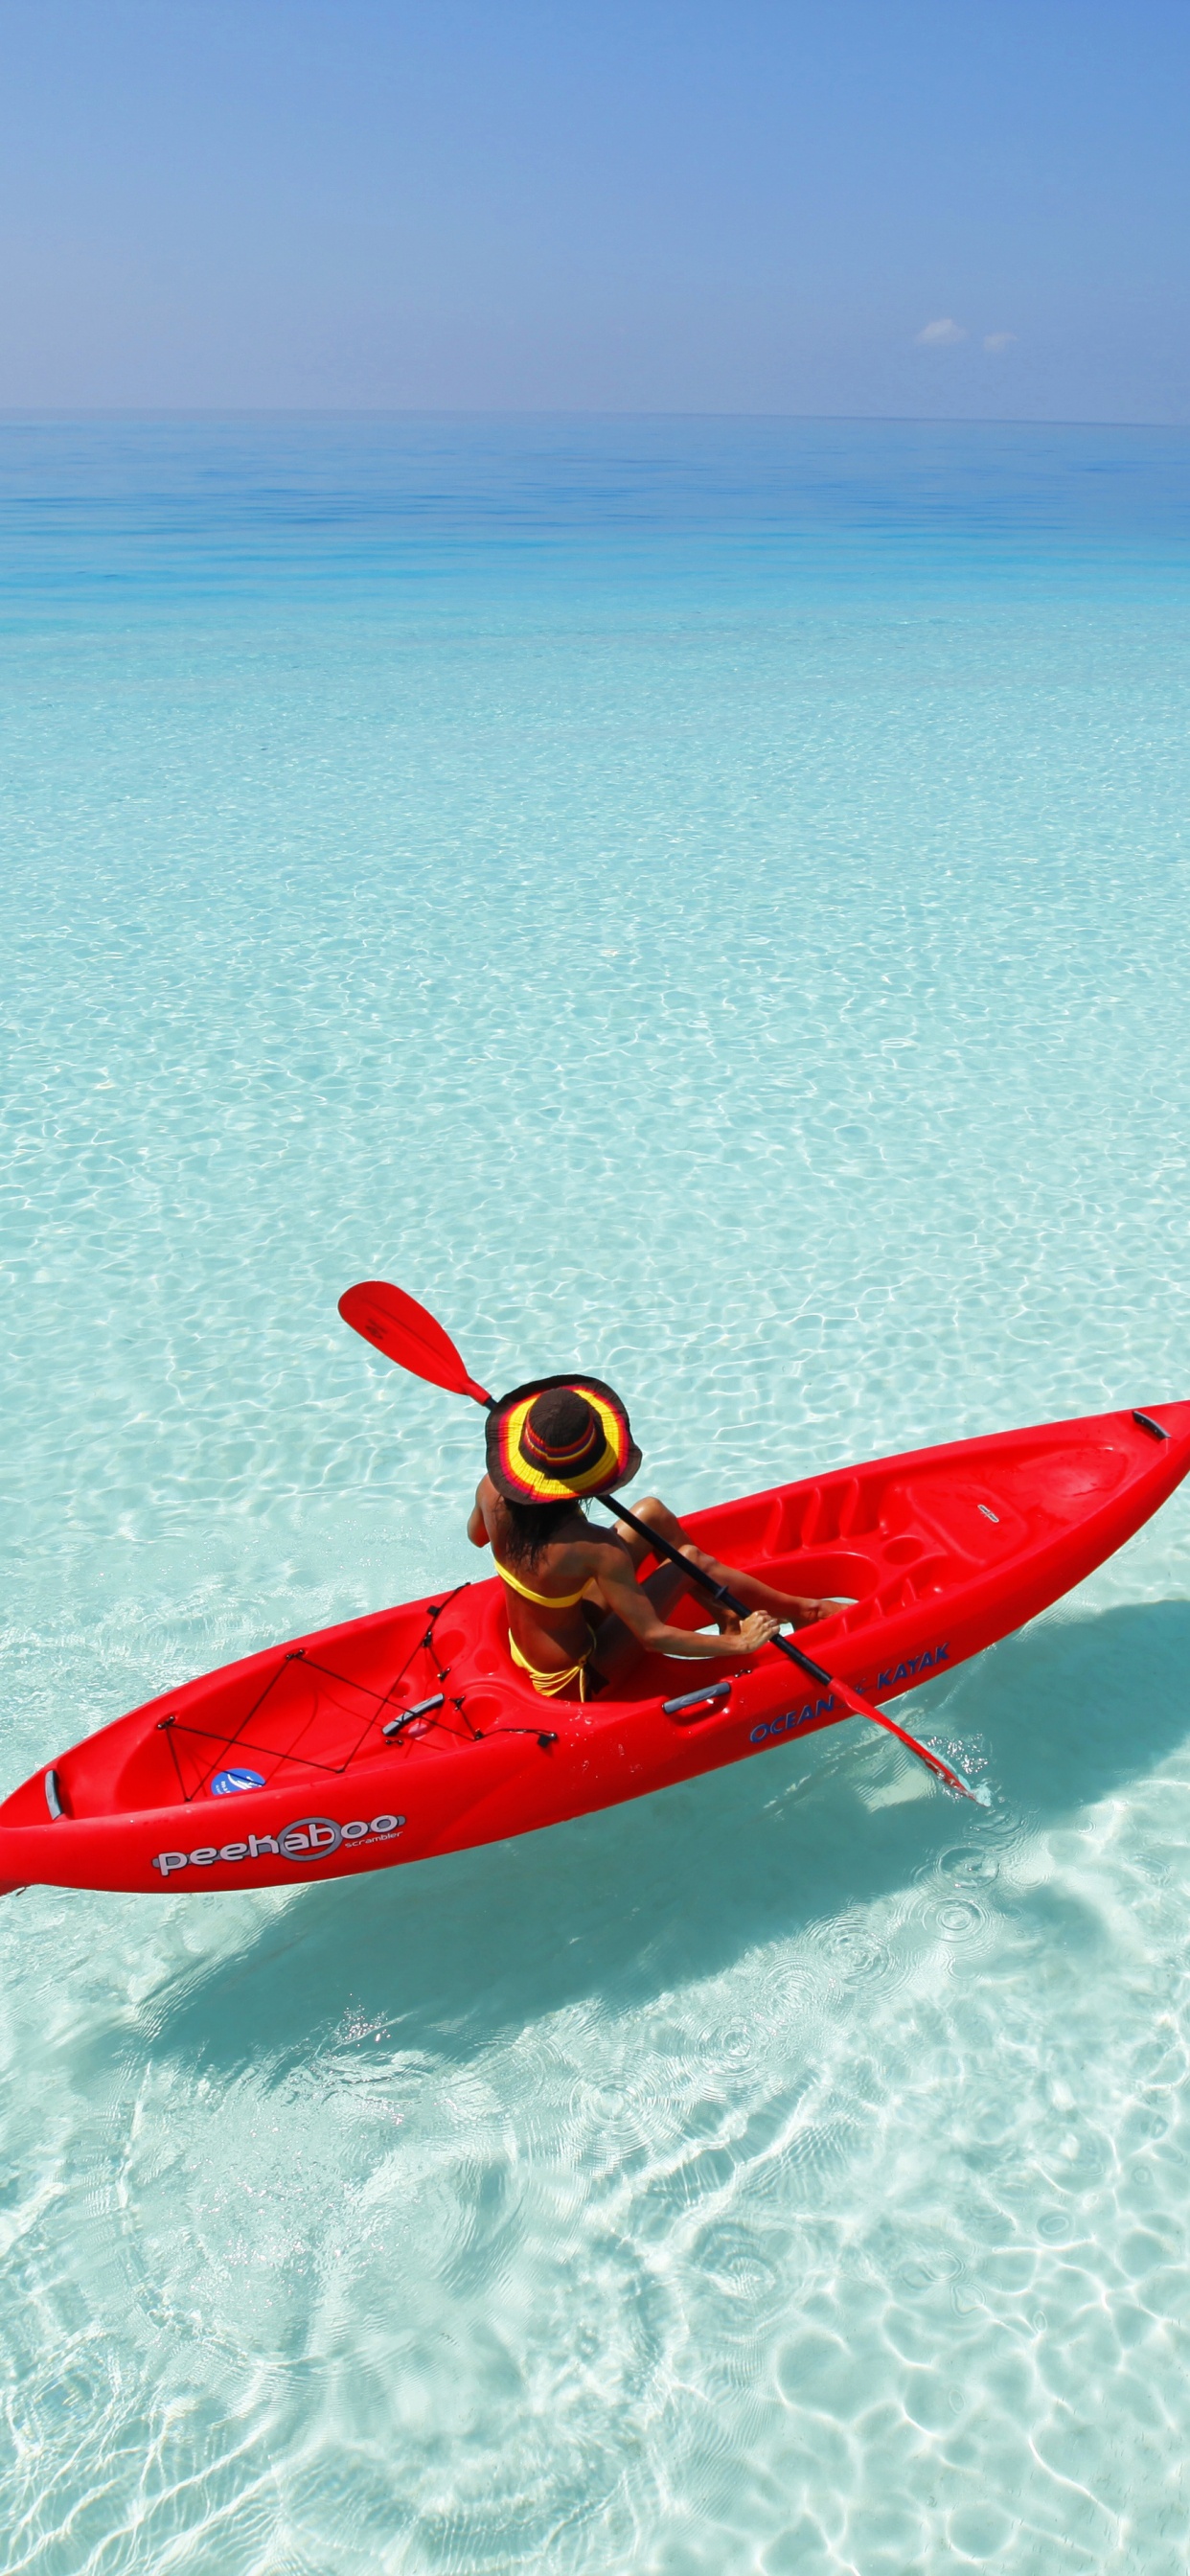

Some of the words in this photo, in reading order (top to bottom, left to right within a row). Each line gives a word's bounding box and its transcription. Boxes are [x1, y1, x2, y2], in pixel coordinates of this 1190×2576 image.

[749, 1693, 835, 1743] OCEAN
[877, 1642, 950, 1690] KAYAK
[157, 1814, 399, 1876] peekaboo
[344, 1830, 404, 1849] scrambler
